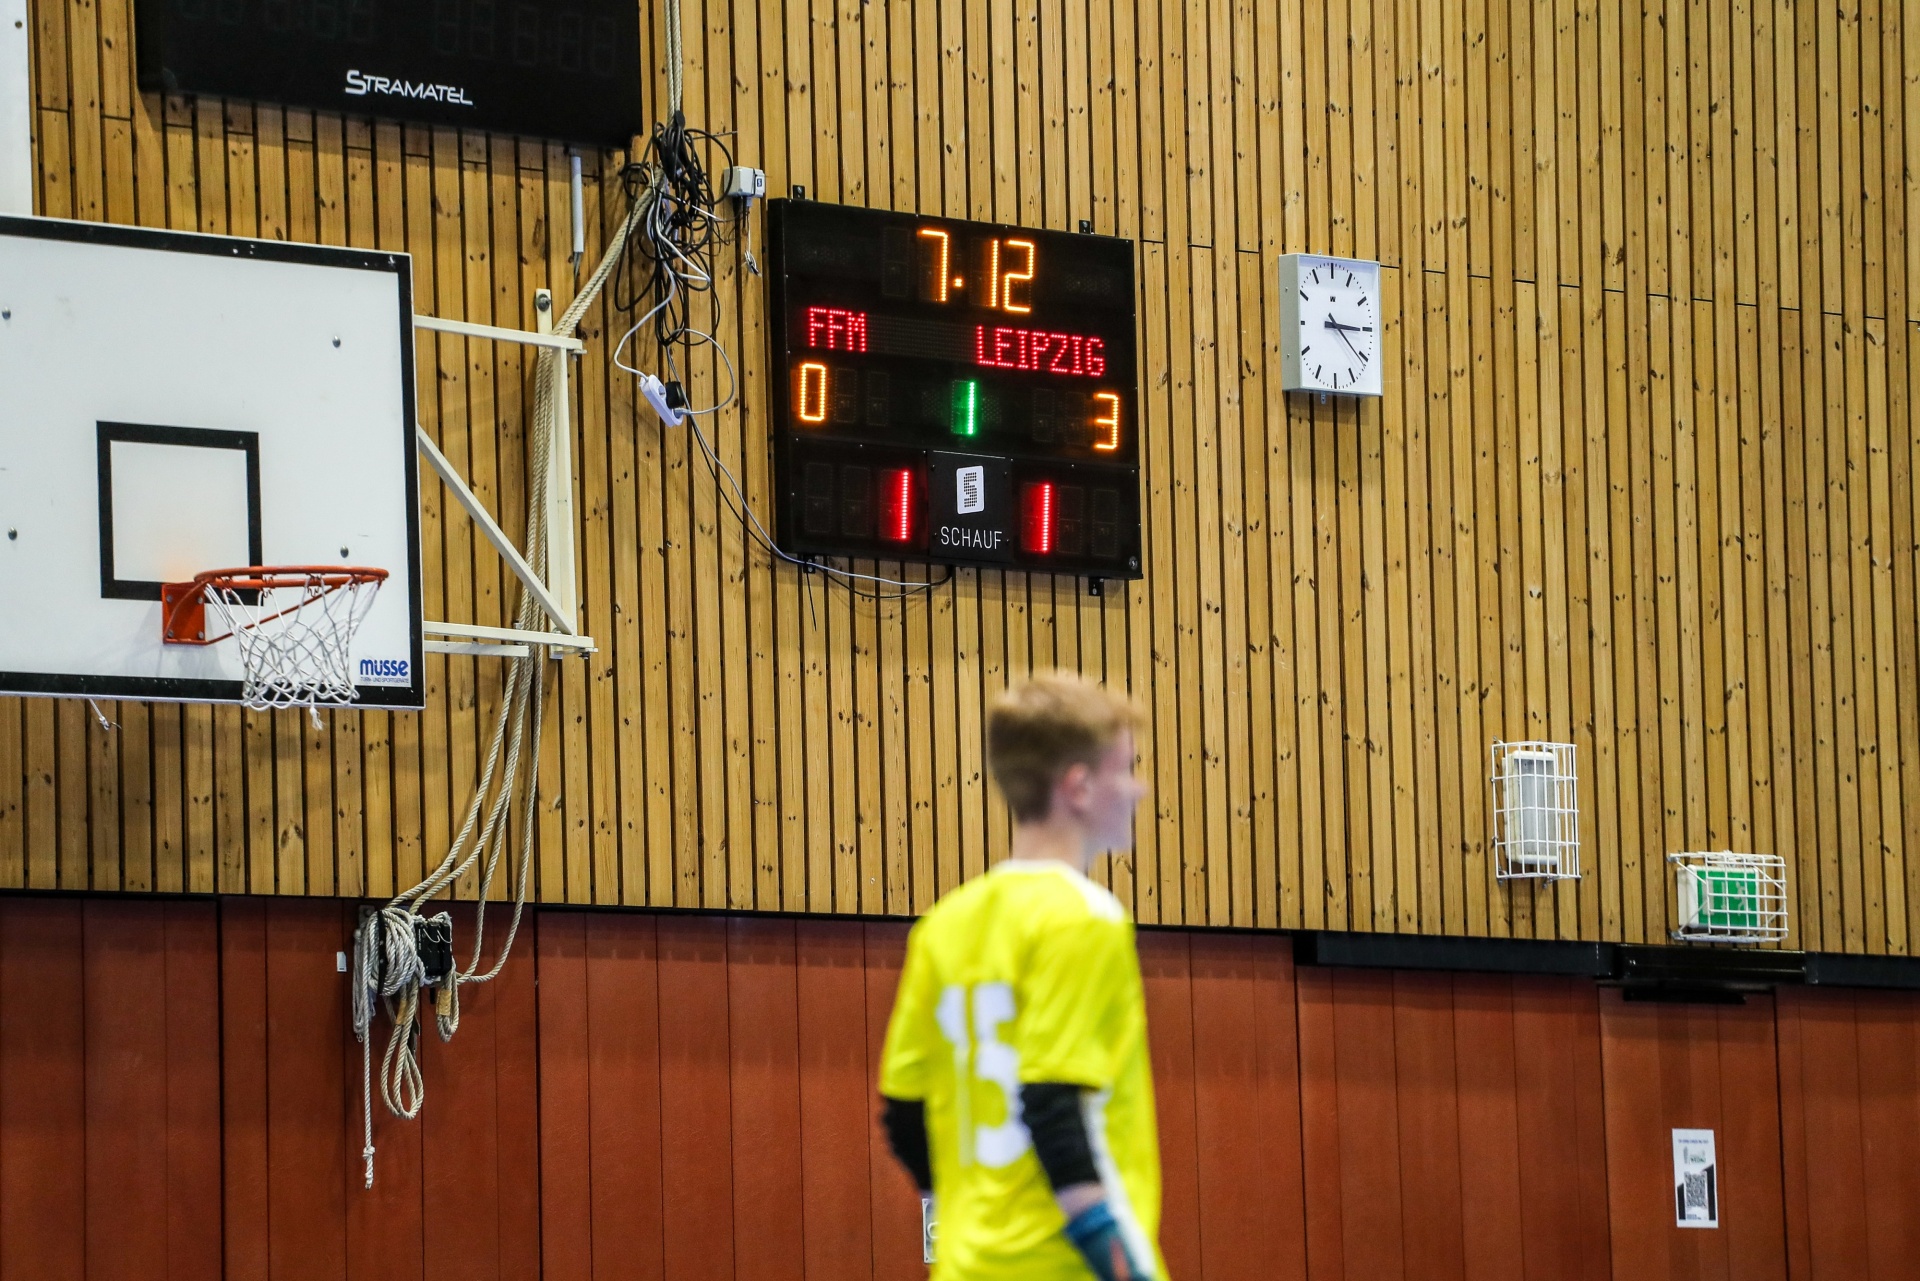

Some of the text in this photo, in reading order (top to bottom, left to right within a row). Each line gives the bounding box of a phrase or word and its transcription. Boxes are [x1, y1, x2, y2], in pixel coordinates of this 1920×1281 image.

[345, 69, 474, 106] STRAMATEL
[808, 306, 867, 352] FFM
[976, 325, 1106, 377] LEIPZIG
[799, 362, 828, 422] 0
[965, 380, 976, 436] 1
[1092, 393, 1120, 450] 3
[899, 470, 911, 540] 1
[1040, 482, 1052, 553] 1
[940, 526, 1003, 550] SCHAUF
[935, 982, 1033, 1169] 15
